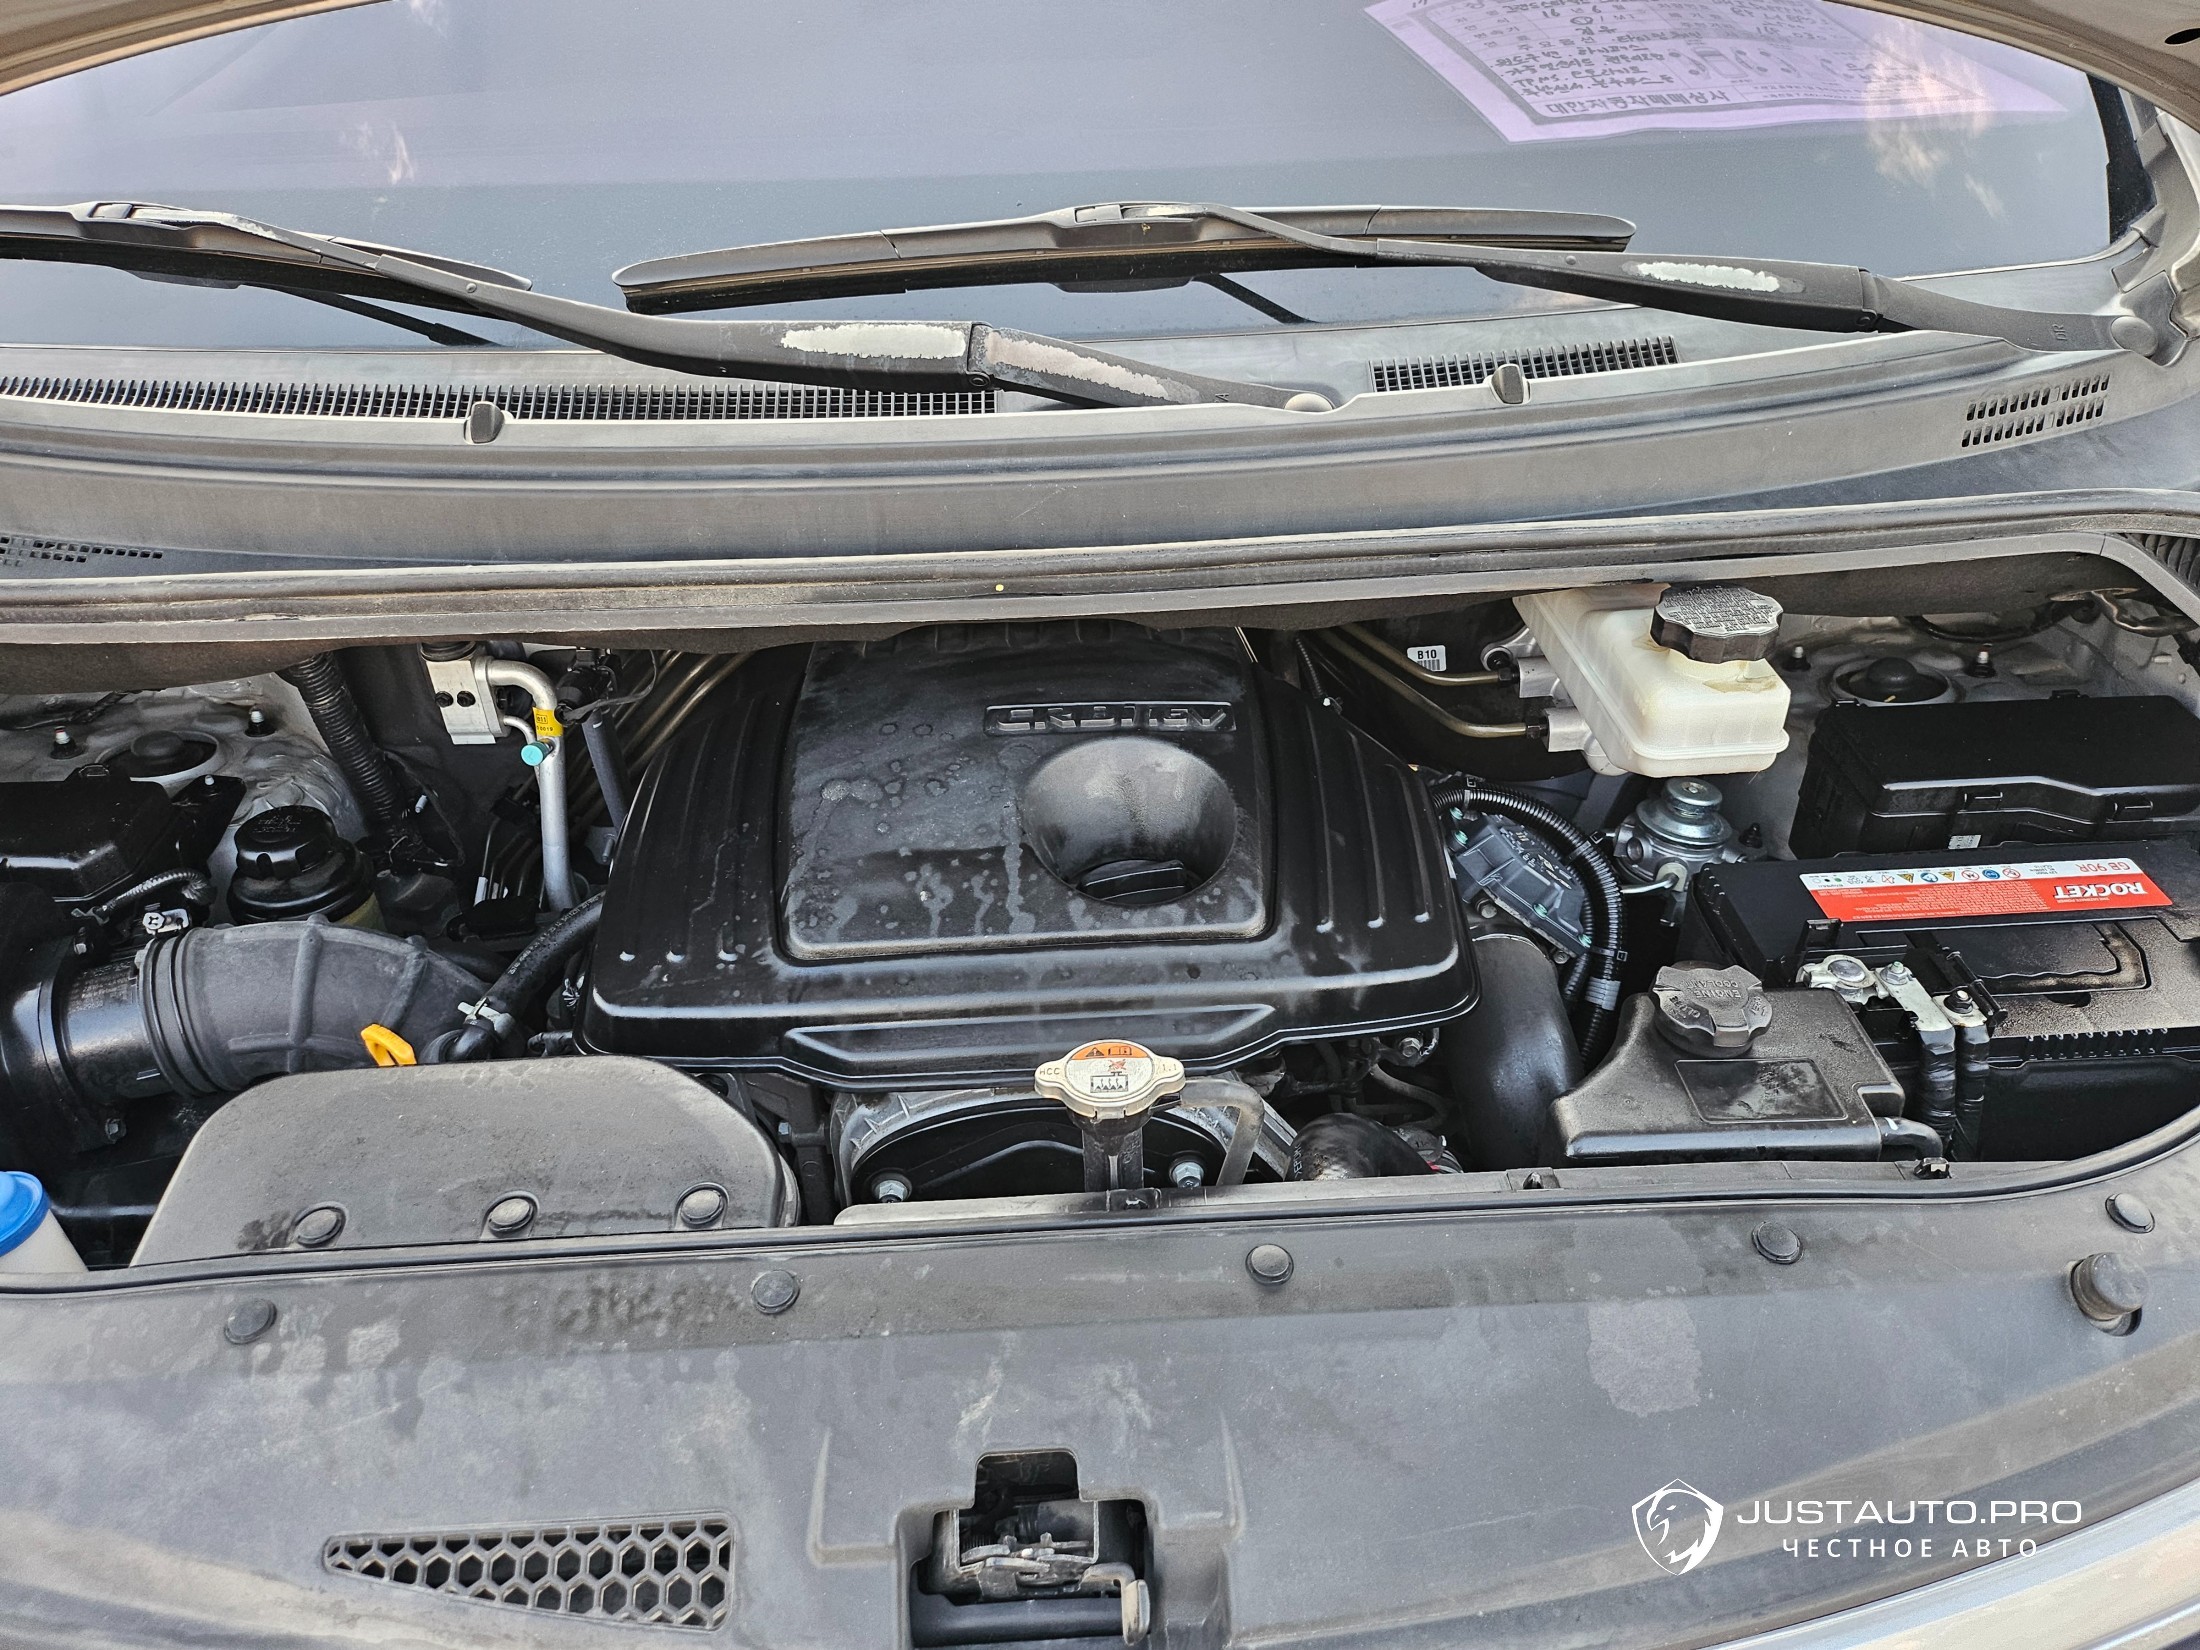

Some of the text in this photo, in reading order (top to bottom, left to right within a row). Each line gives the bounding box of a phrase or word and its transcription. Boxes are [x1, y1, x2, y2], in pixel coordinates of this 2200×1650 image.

[1417, 649, 1437, 660] B10
[2109, 861, 2131, 871] GB
[2053, 882, 2147, 899] ROCKET
[1693, 989, 1741, 999] ENGINE
[1039, 1066, 1061, 1076] HCC
